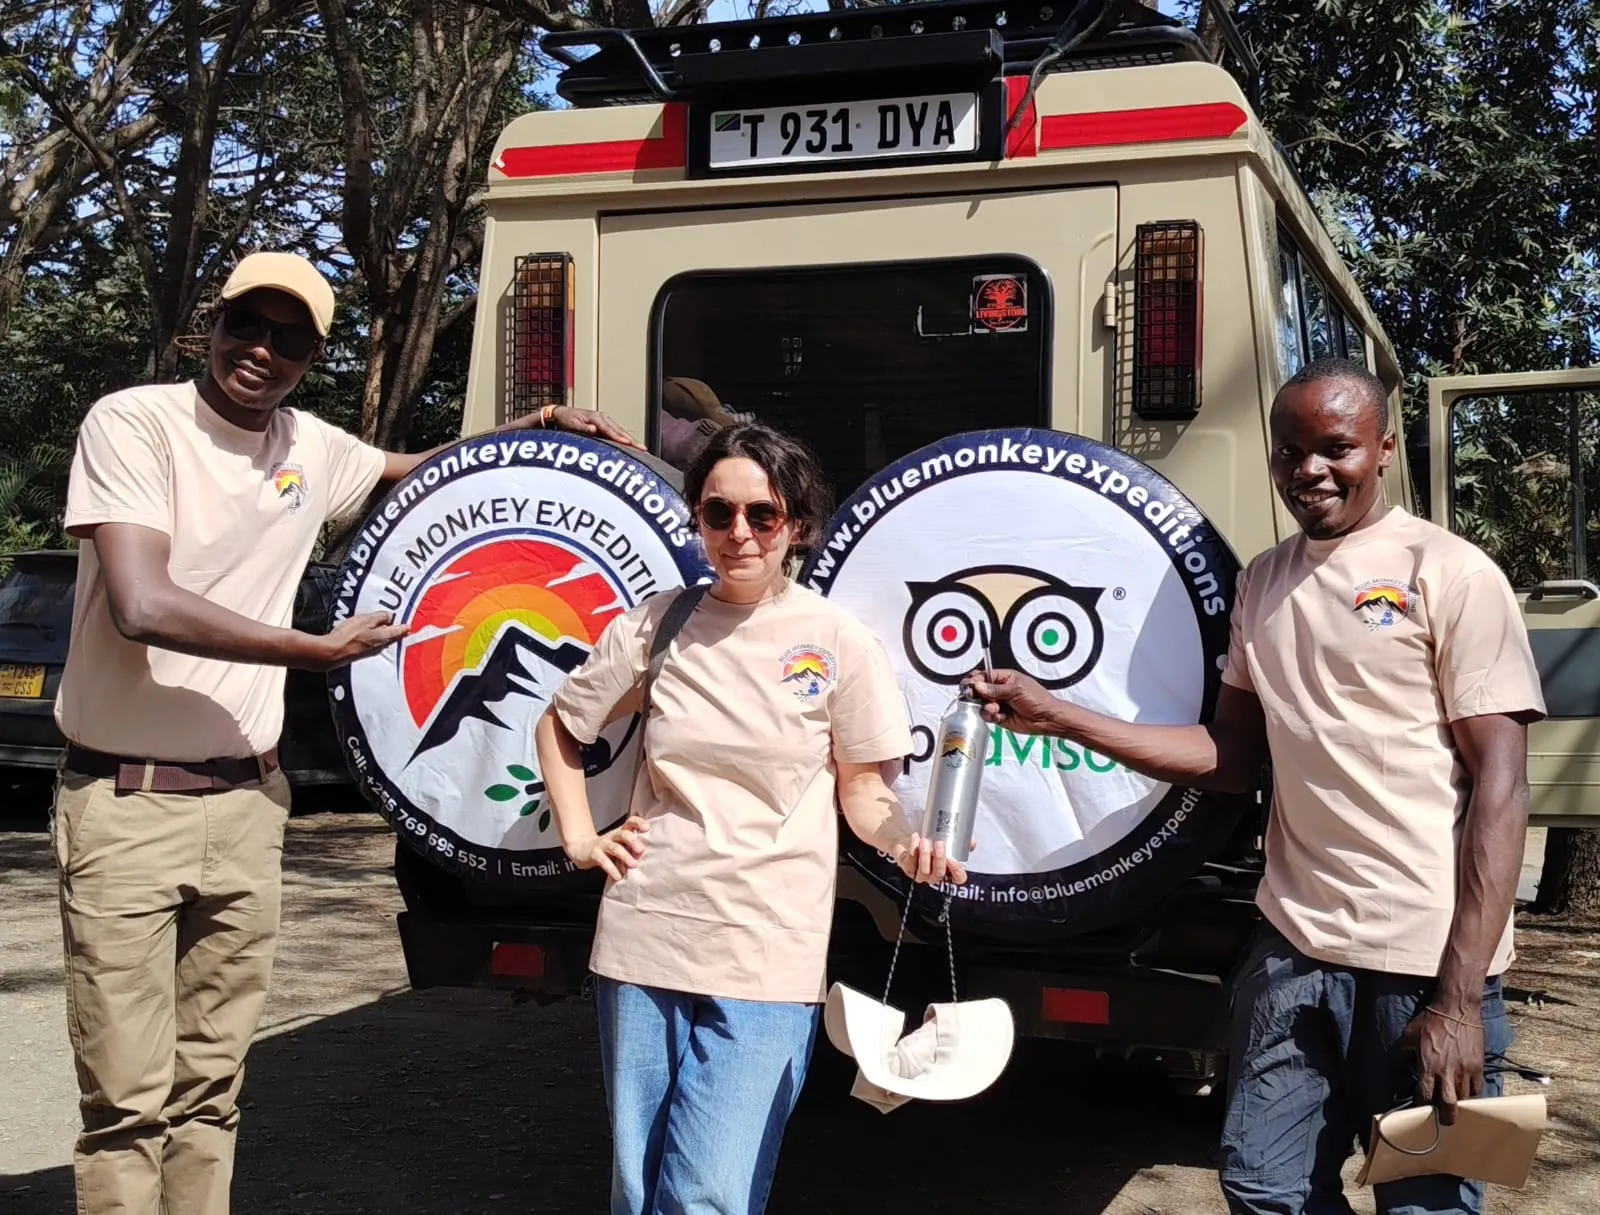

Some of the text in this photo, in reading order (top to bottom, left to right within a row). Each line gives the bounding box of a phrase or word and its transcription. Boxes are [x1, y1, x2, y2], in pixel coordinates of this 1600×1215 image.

[743, 100, 956, 157] T 931 DYA
[333, 439, 692, 627] ww.bluemonkeyexpeditions
[404, 497, 530, 570] MONKEY
[347, 736, 368, 773] Call:
[366, 775, 397, 812] +255
[397, 808, 428, 836] 769
[428, 832, 455, 858] 695
[457, 849, 487, 871] 552
[511, 860, 560, 877] Email:
[990, 787, 1203, 905] info@bluemonkeyexpedit
